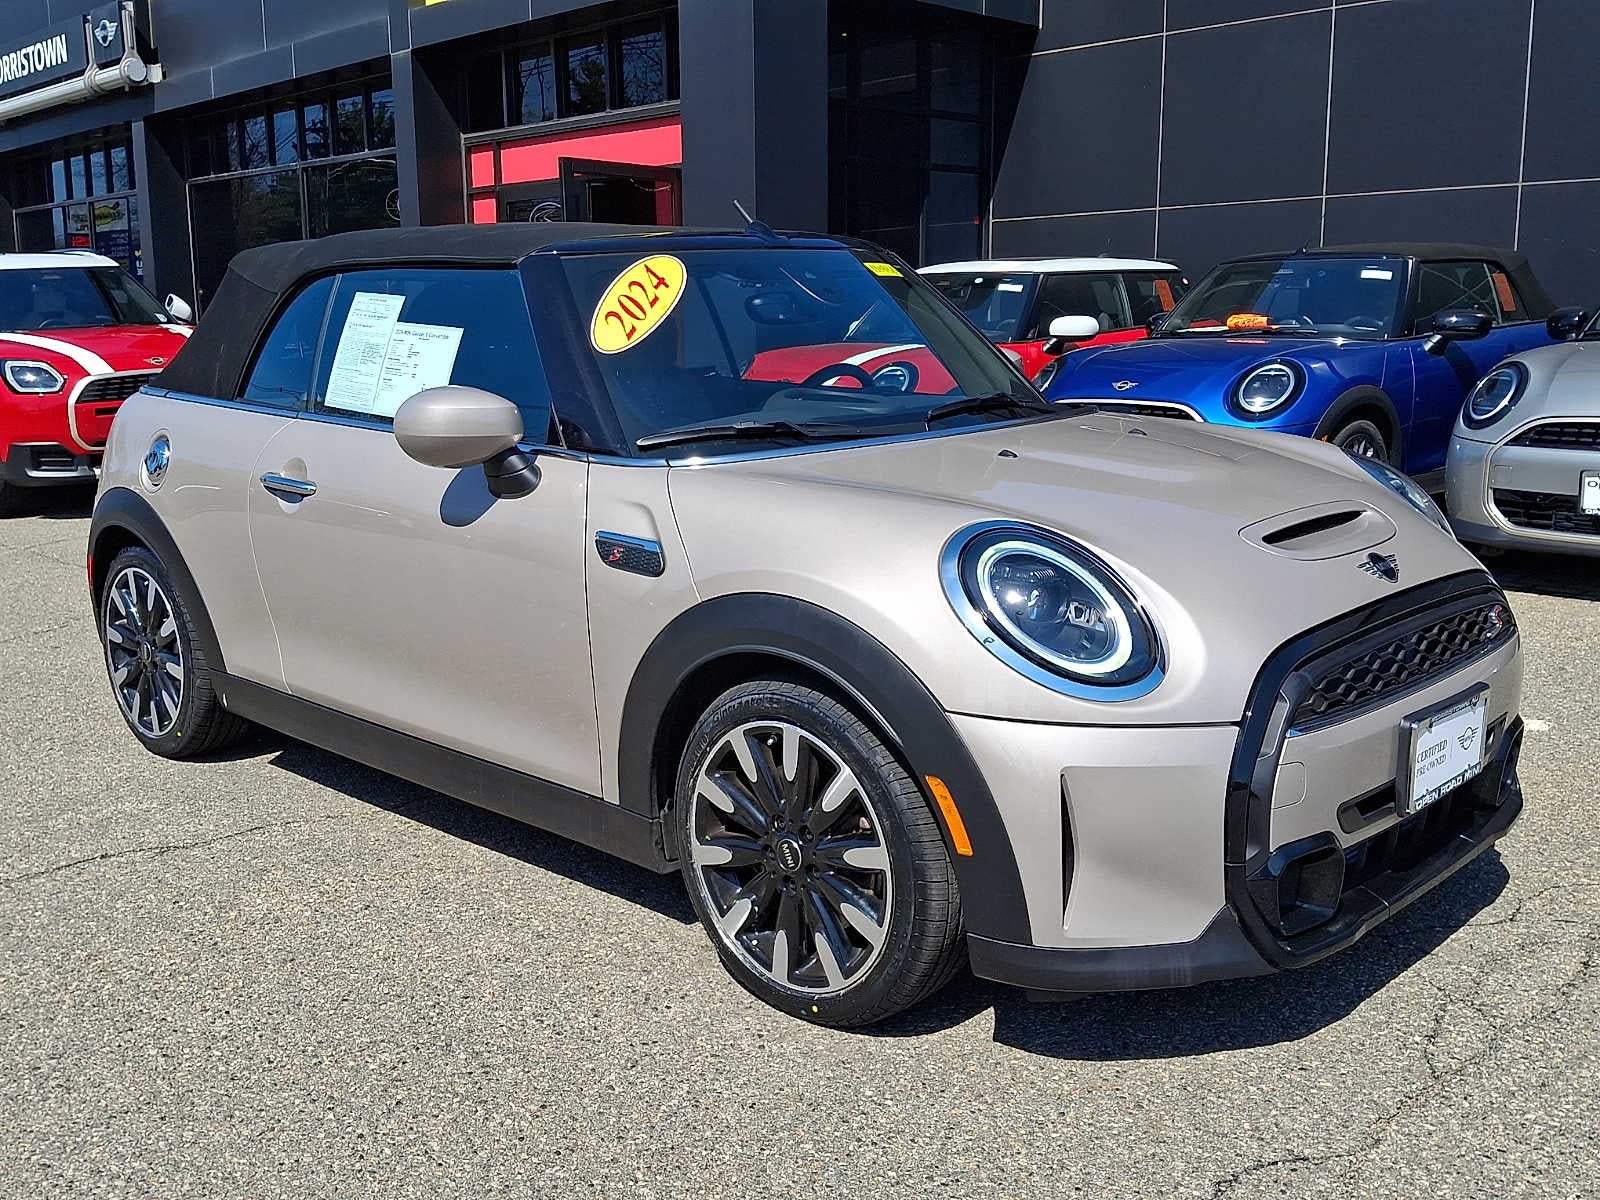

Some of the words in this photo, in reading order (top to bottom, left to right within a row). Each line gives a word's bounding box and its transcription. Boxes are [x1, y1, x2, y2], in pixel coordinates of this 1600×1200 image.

[604, 263, 670, 342] 2024
[1416, 739, 1448, 764] CERTIFIED
[1416, 754, 1447, 778] PRE-OWNED
[1415, 788, 1439, 810] OPEN
[1440, 775, 1463, 797] ROAD
[782, 843, 795, 868] MINI
